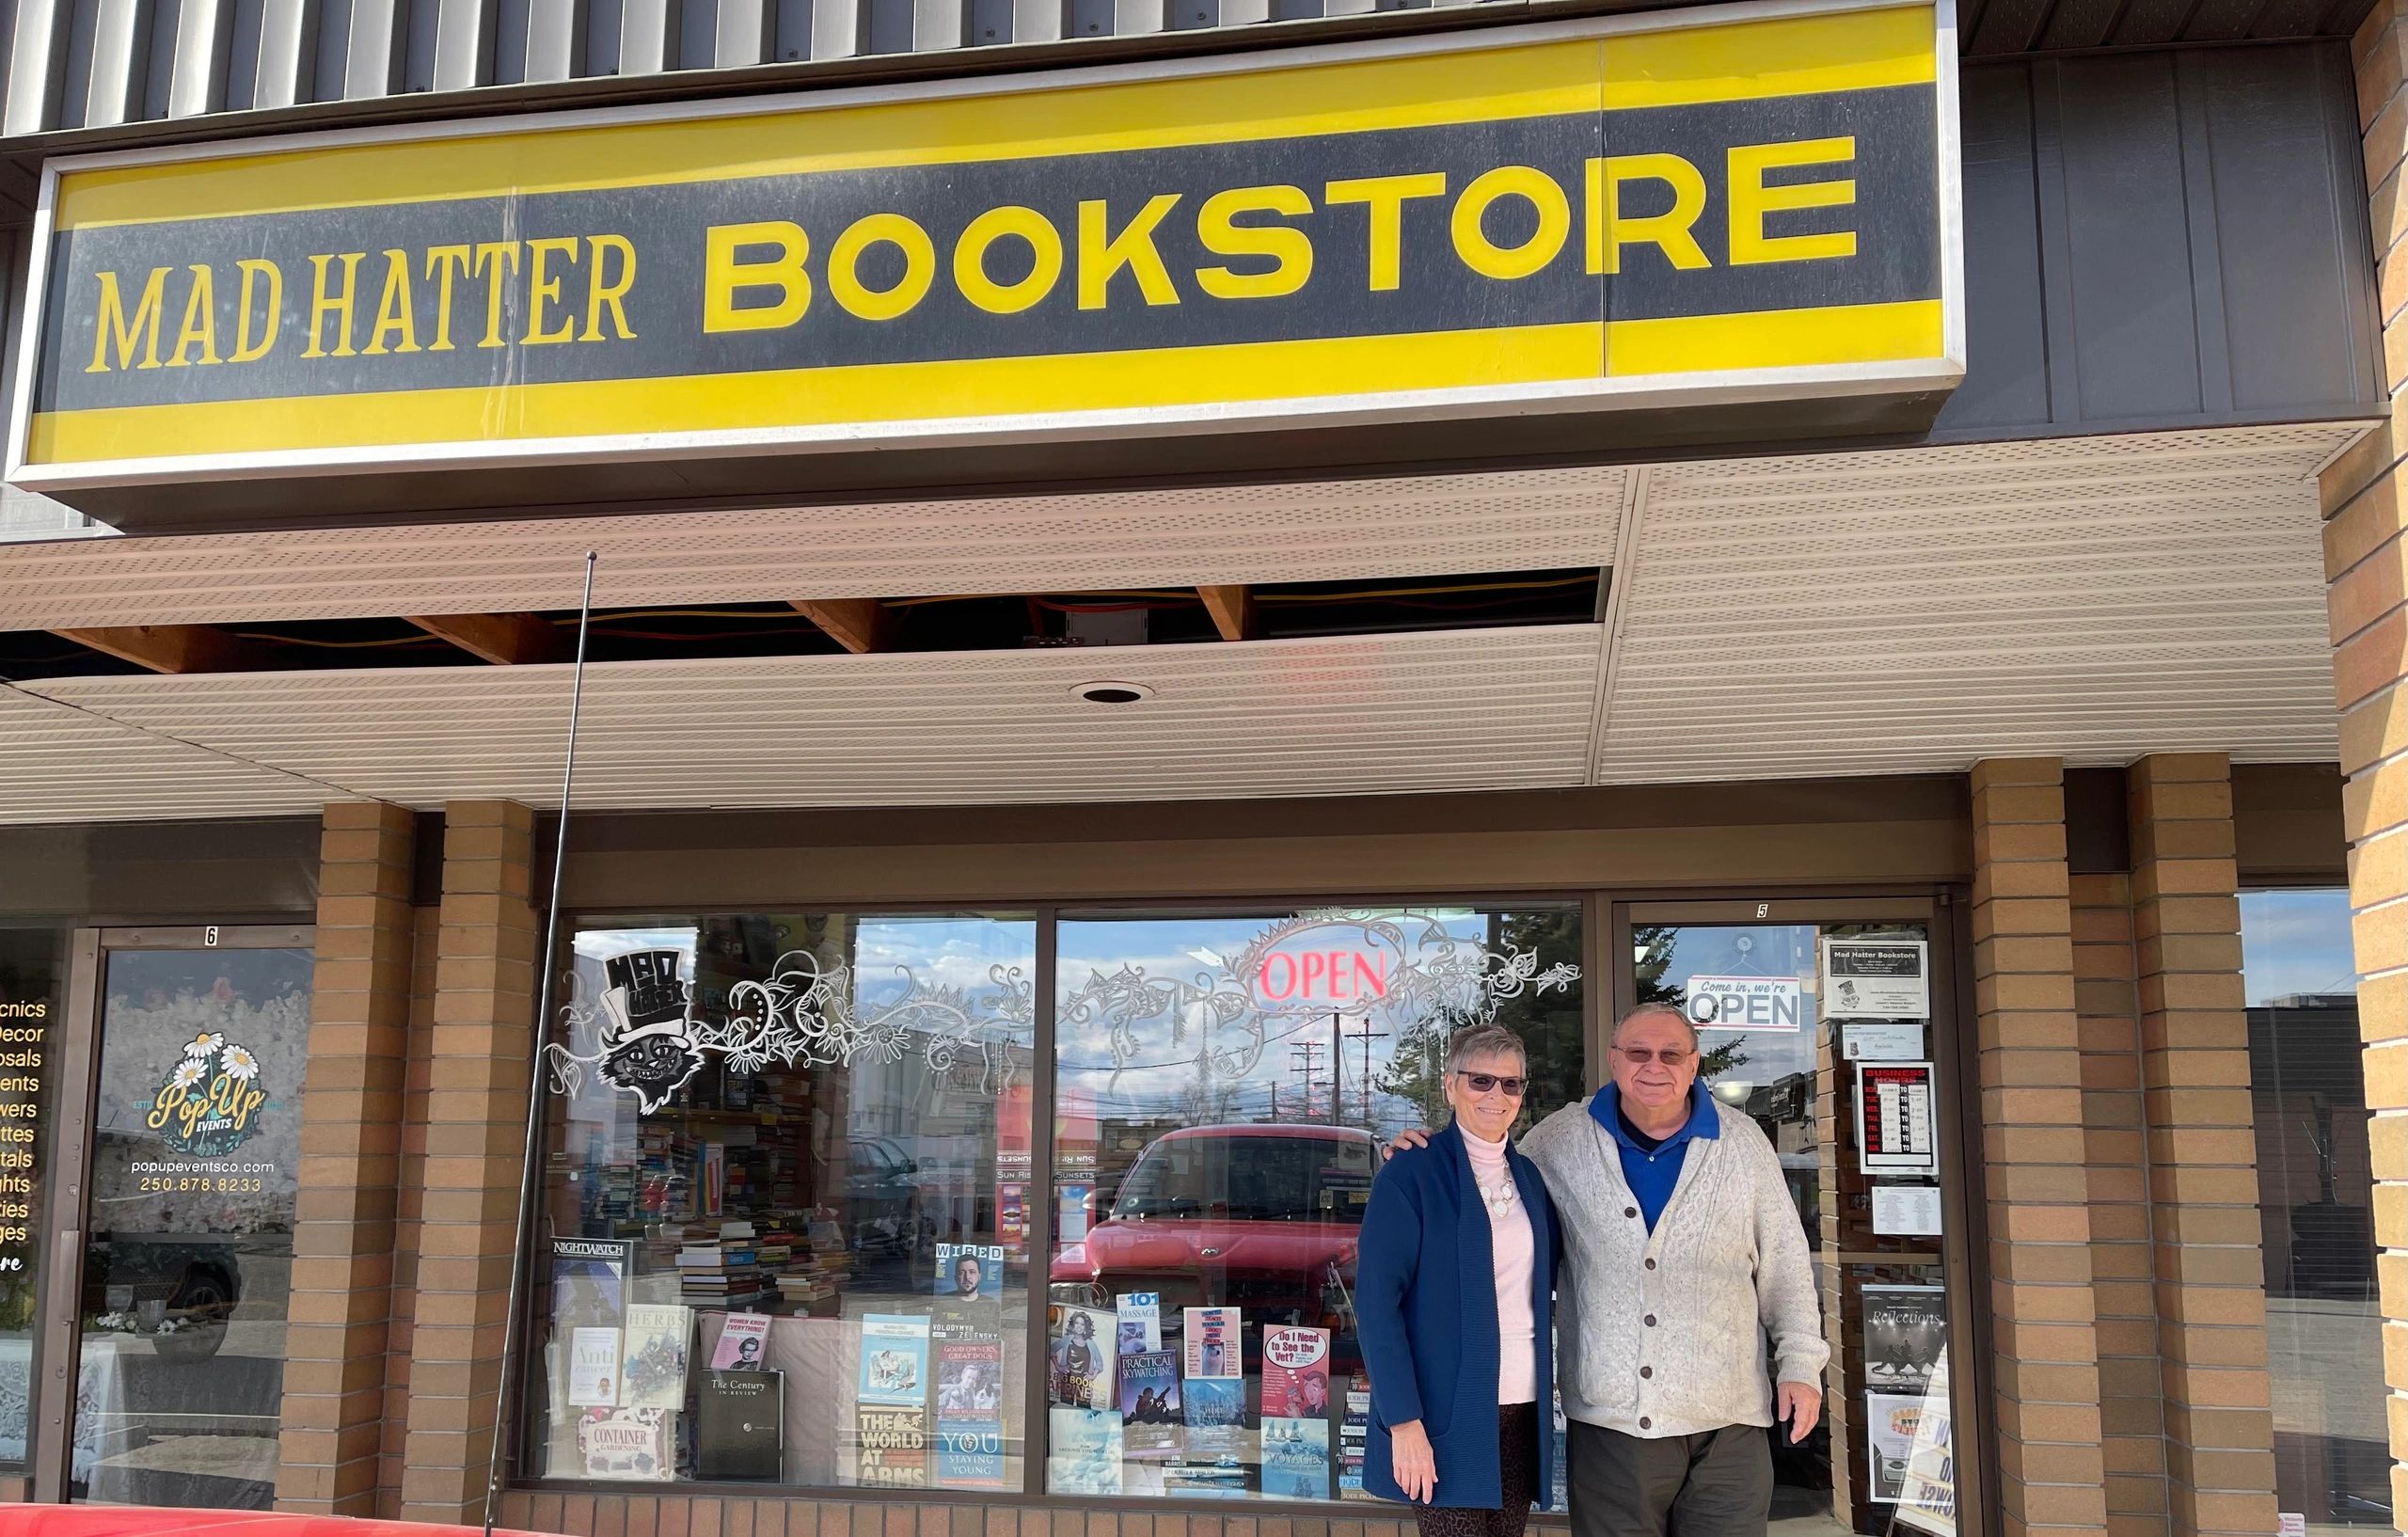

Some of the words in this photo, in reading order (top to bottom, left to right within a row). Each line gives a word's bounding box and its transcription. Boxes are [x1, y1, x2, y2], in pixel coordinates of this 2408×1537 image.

[85, 258, 283, 373] MAD
[300, 233, 638, 358] HATTER
[704, 135, 1857, 335] BOOKSTORE
[1758, 905, 1767, 917] 5
[207, 927, 215, 944] 6
[1259, 950, 1386, 1002] OPEN
[1701, 981, 1732, 992] Come
[1735, 982, 1751, 993] in,
[1754, 981, 1786, 993] we're
[1689, 992, 1798, 1024] OPEN
[0, 1026, 44, 1042] ecor
[0, 1076, 40, 1091] ents
[148, 1081, 214, 1138] Pop
[209, 1072, 266, 1131] Up
[196, 1117, 233, 1133] EVENTS
[131, 1161, 275, 1174] popupeventsco.com
[140, 1177, 261, 1192] 250.878.8233
[553, 1242, 624, 1256] NIGHTWATCH
[936, 1244, 1003, 1260] WIRED
[1128, 1293, 1159, 1306] 101
[628, 1313, 686, 1326] HERBS
[1120, 1309, 1157, 1318] MASSAGE
[1873, 1310, 1941, 1324] Reflections
[726, 1324, 765, 1333] EVERYTHING!
[1278, 1332, 1290, 1341] Do
[1298, 1332, 1319, 1342] Need
[1272, 1341, 1280, 1351] to
[1283, 1342, 1298, 1352] See
[1301, 1343, 1314, 1353] the
[1122, 1356, 1173, 1369] PRACTICAL
[1275, 1352, 1294, 1362] Vet?
[1122, 1366, 1174, 1379] SKYWATCHING
[711, 1379, 727, 1388] The
[730, 1379, 766, 1391] Century
[1069, 1375, 1095, 1388] BOOK
[1049, 1380, 1107, 1402] APPINESS
[860, 1415, 893, 1431] THE
[594, 1429, 647, 1446] CONTAINER
[861, 1433, 923, 1449] WORLD
[942, 1433, 998, 1453] YOU
[861, 1450, 882, 1466] AT
[949, 1455, 993, 1464] STAYING
[1269, 1452, 1323, 1466] VOYAGES
[863, 1466, 926, 1484] ARMS
[952, 1466, 991, 1475] YOUNG
